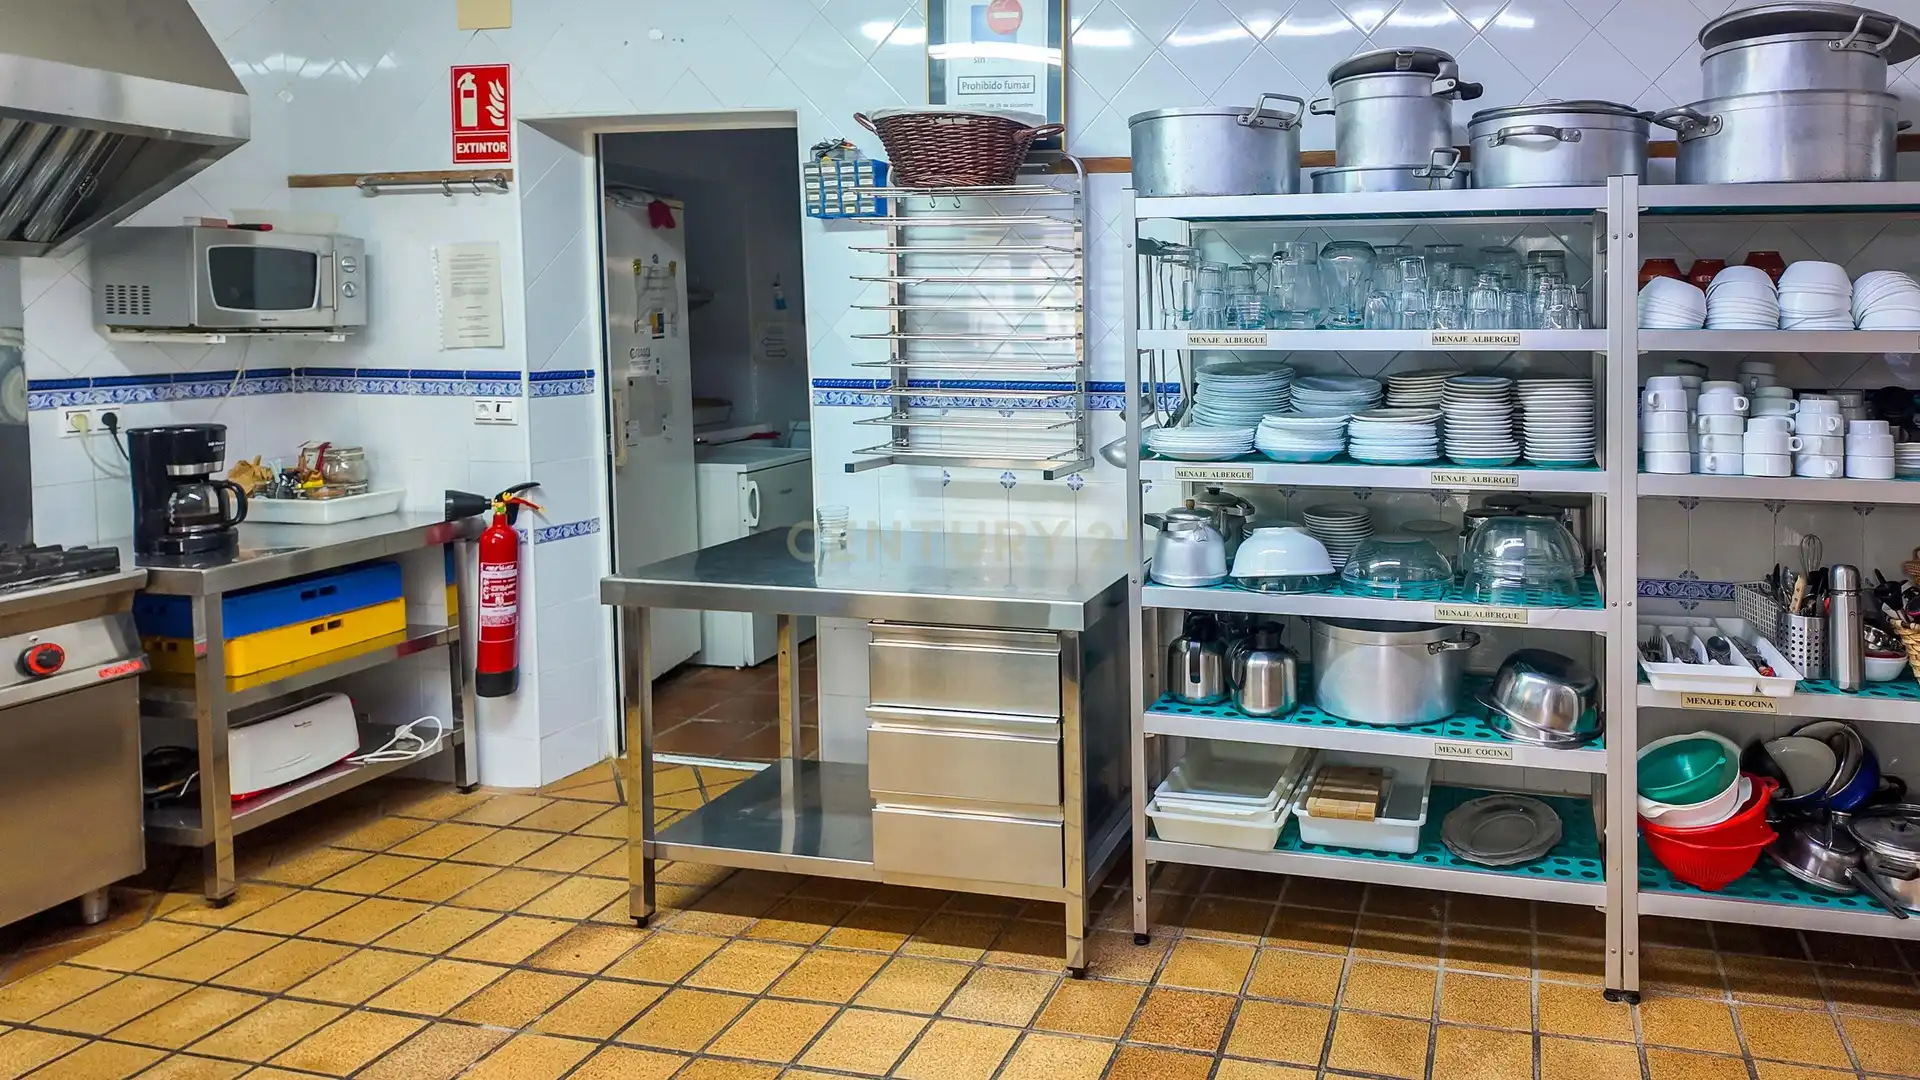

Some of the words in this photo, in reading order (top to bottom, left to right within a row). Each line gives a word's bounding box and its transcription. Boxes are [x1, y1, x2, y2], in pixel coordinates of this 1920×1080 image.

[961, 81, 1003, 91] Prohibido
[1004, 80, 1031, 90] fumar
[456, 141, 507, 154] EXTINTOR
[1189, 336, 1221, 344] MENAJE
[1223, 336, 1266, 344] ALBERGUE
[1433, 335, 1469, 343] MENAJE
[1471, 336, 1519, 344] ALBERGUE
[1176, 470, 1208, 478] MENAJE
[1211, 471, 1252, 479] ALBERGUE
[1433, 474, 1467, 482] MENAJE
[1470, 476, 1517, 484] ALBERGUE
[1438, 608, 1473, 617] MENAJE
[1474, 611, 1520, 620] ALBERGUE
[1686, 696, 1722, 706] MENAJE
[1724, 699, 1737, 707] DE
[1738, 700, 1774, 709] COCINA
[1438, 745, 1472, 755] MENAJE
[1475, 748, 1509, 757] COCINA
